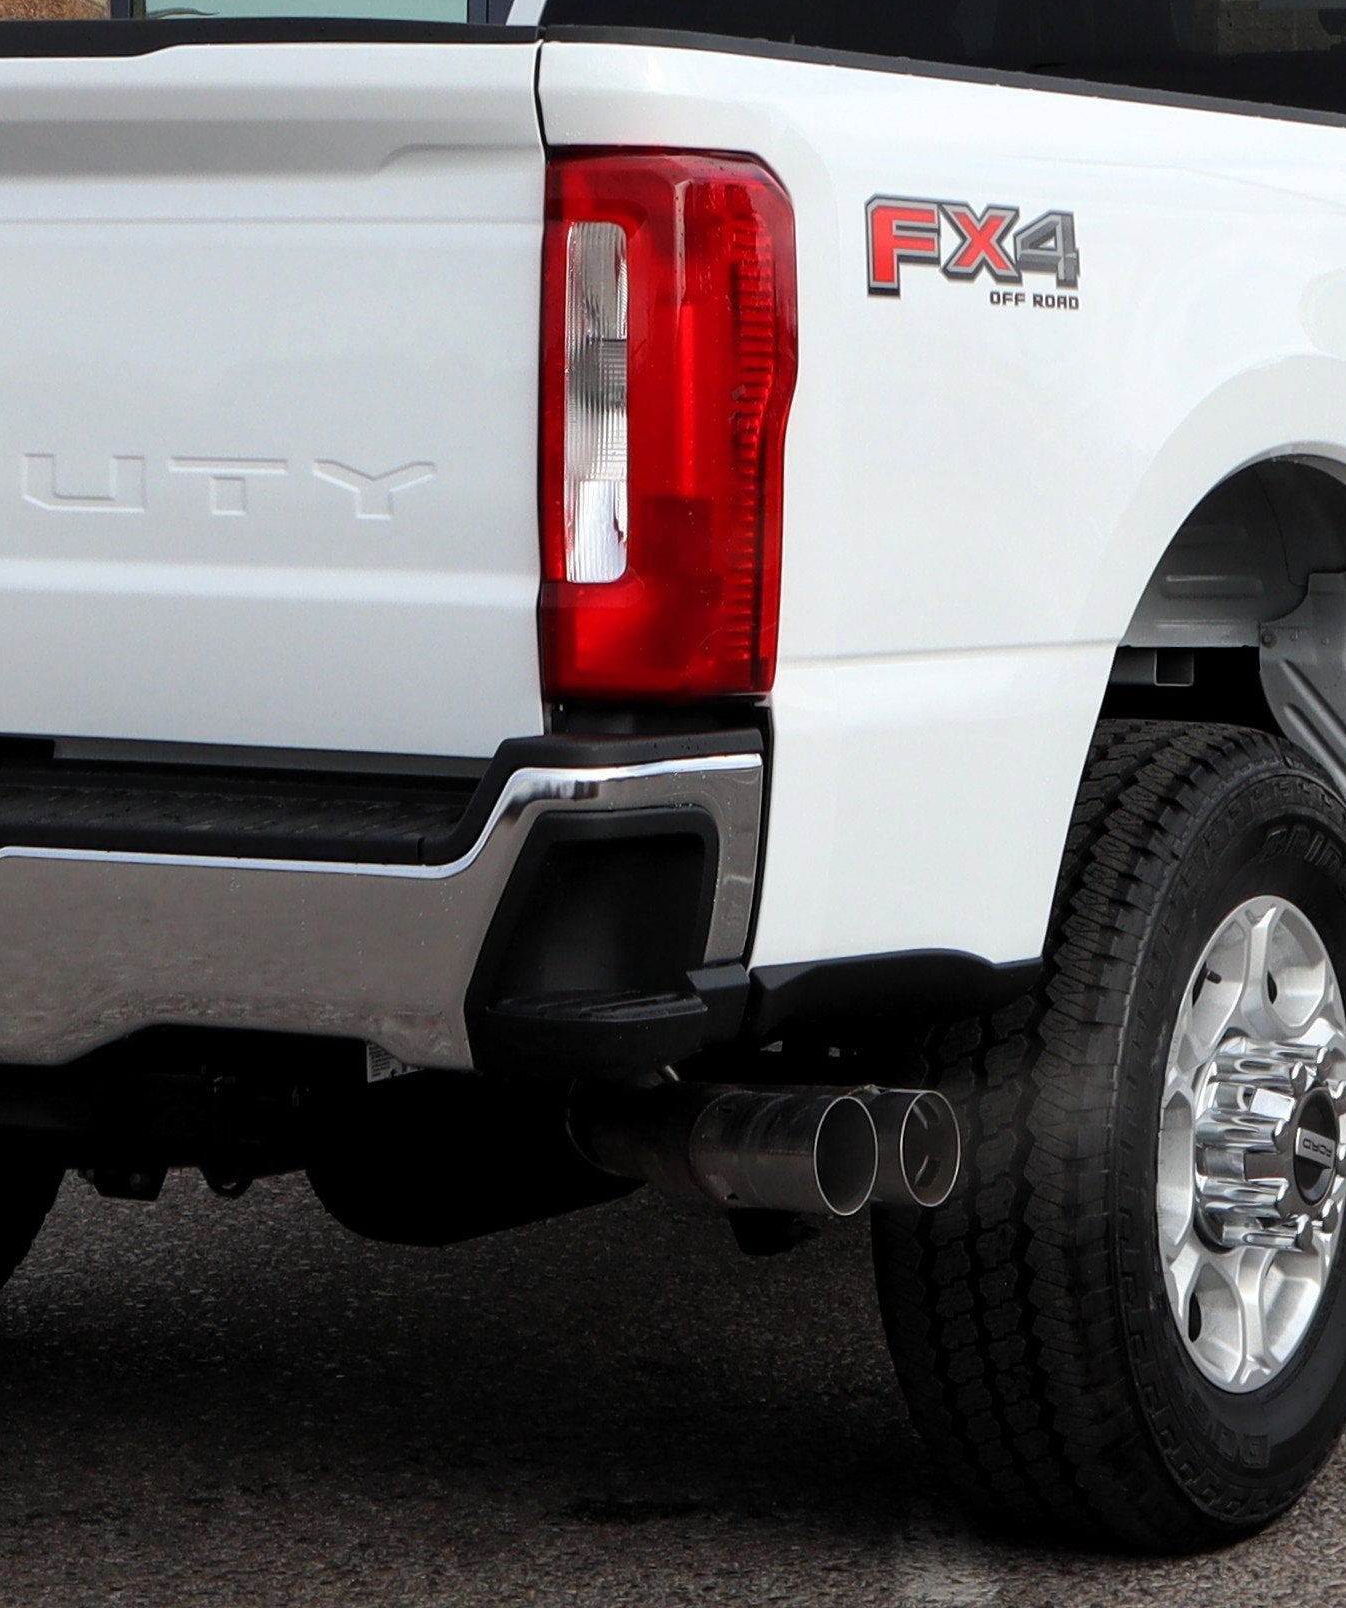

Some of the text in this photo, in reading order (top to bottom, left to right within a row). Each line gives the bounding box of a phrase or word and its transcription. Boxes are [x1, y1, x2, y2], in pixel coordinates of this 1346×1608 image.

[864, 193, 1081, 297] FX4
[989, 291, 1080, 310] OFF ROAD
[1302, 1137, 1333, 1158] FORD
